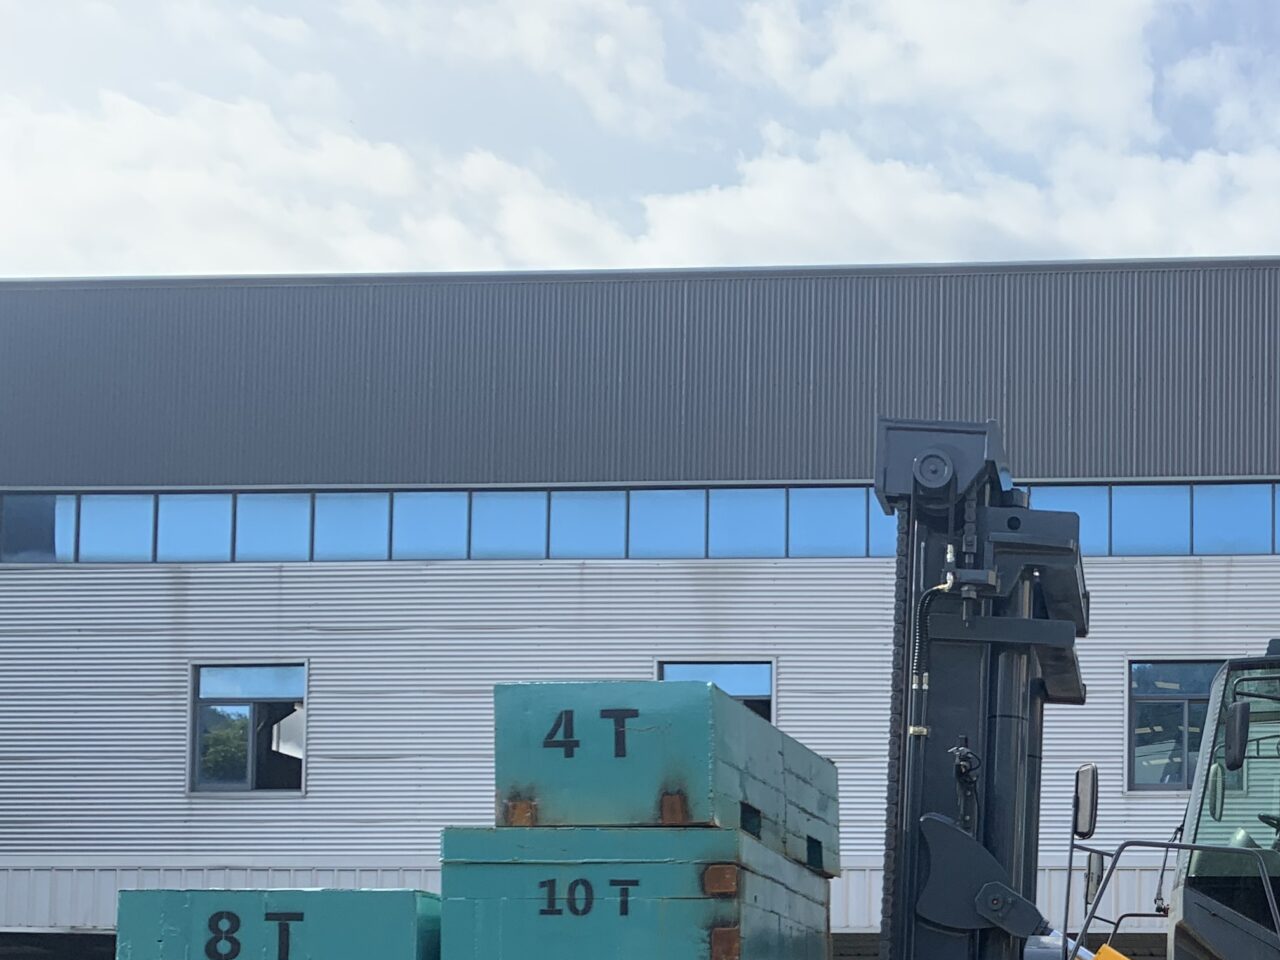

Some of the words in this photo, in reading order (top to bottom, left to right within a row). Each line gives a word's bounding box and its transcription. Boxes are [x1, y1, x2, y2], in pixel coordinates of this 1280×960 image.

[541, 708, 581, 759] 4
[599, 707, 641, 759] T
[537, 877, 595, 917] 10
[608, 877, 641, 917] T
